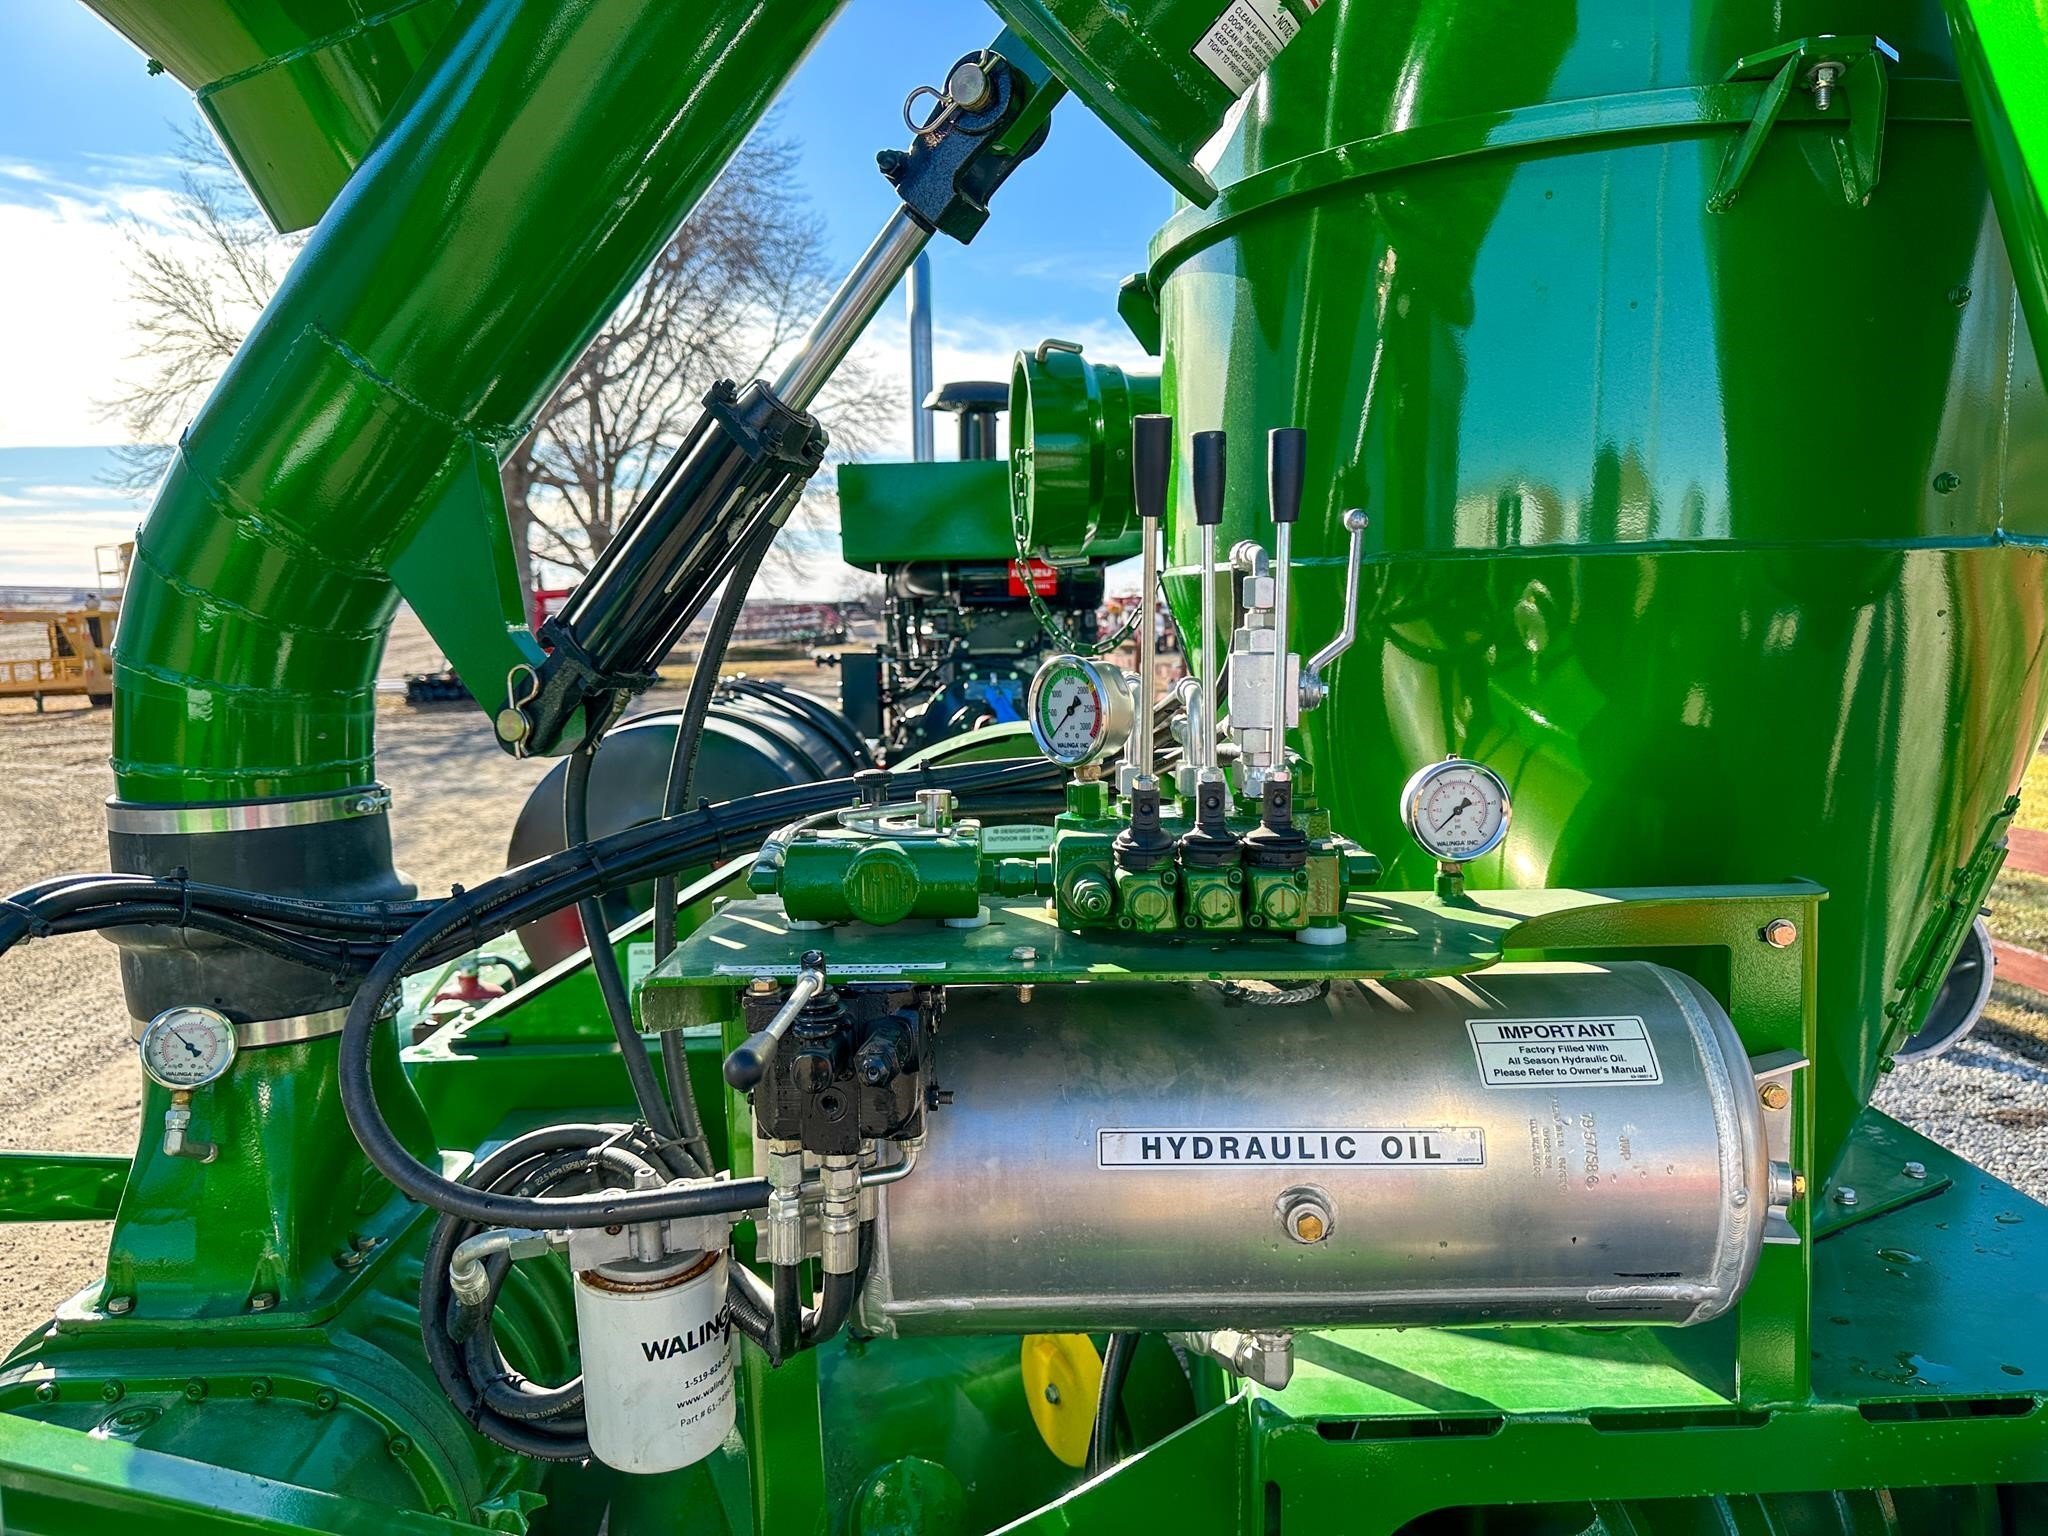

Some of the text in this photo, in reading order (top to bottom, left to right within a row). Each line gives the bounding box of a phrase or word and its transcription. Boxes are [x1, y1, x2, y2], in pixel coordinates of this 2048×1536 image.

[1219, 21, 1239, 43] CLEAN
[1233, 5, 1254, 27] CLEAN
[1248, 23, 1267, 42] FLANGE
[1212, 30, 1229, 47] KEEP
[1225, 43, 1244, 64] GASKET
[1235, 39, 1244, 48] IN
[1241, 31, 1255, 45] THIS
[1250, 40, 1267, 58] GASKET
[1205, 38, 1244, 79] TIGHT TO PREVENT
[1239, 44, 1256, 61] ORDER
[1498, 1023, 1616, 1040] IMPORTANT
[1518, 1044, 1609, 1055] Factory Filled With
[1507, 1054, 1628, 1066] All Season Hydraulic Oil.
[1493, 1064, 1647, 1077] Please Refer to Owner's Manual
[1141, 1136, 1442, 1160] HYDRAULIC OIL
[680, 1413, 699, 1428] Part
